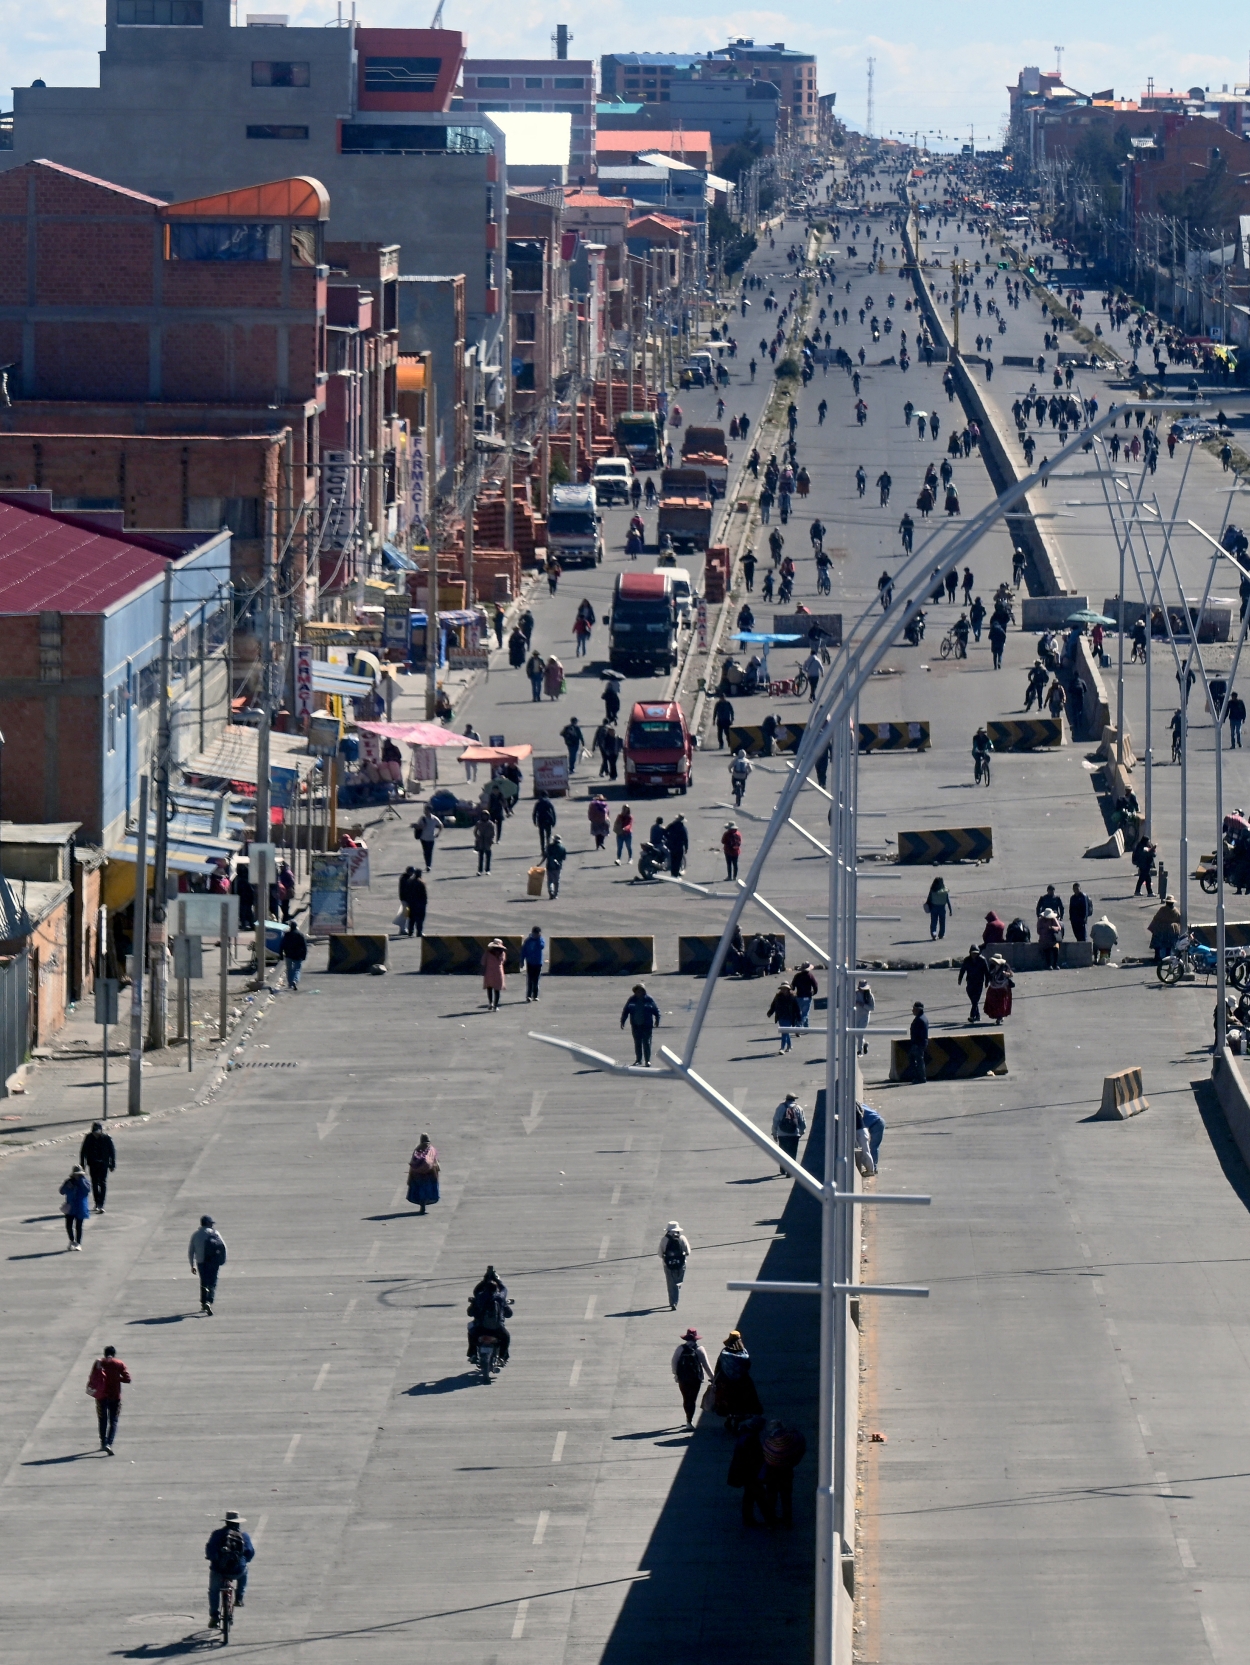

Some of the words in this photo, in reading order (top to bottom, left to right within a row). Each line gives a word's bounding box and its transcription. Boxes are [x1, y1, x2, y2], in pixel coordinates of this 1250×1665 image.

[410, 438, 424, 524] FARMACIA
[697, 600, 707, 648] FARMACIA
[297, 651, 312, 719] FARMACIA
